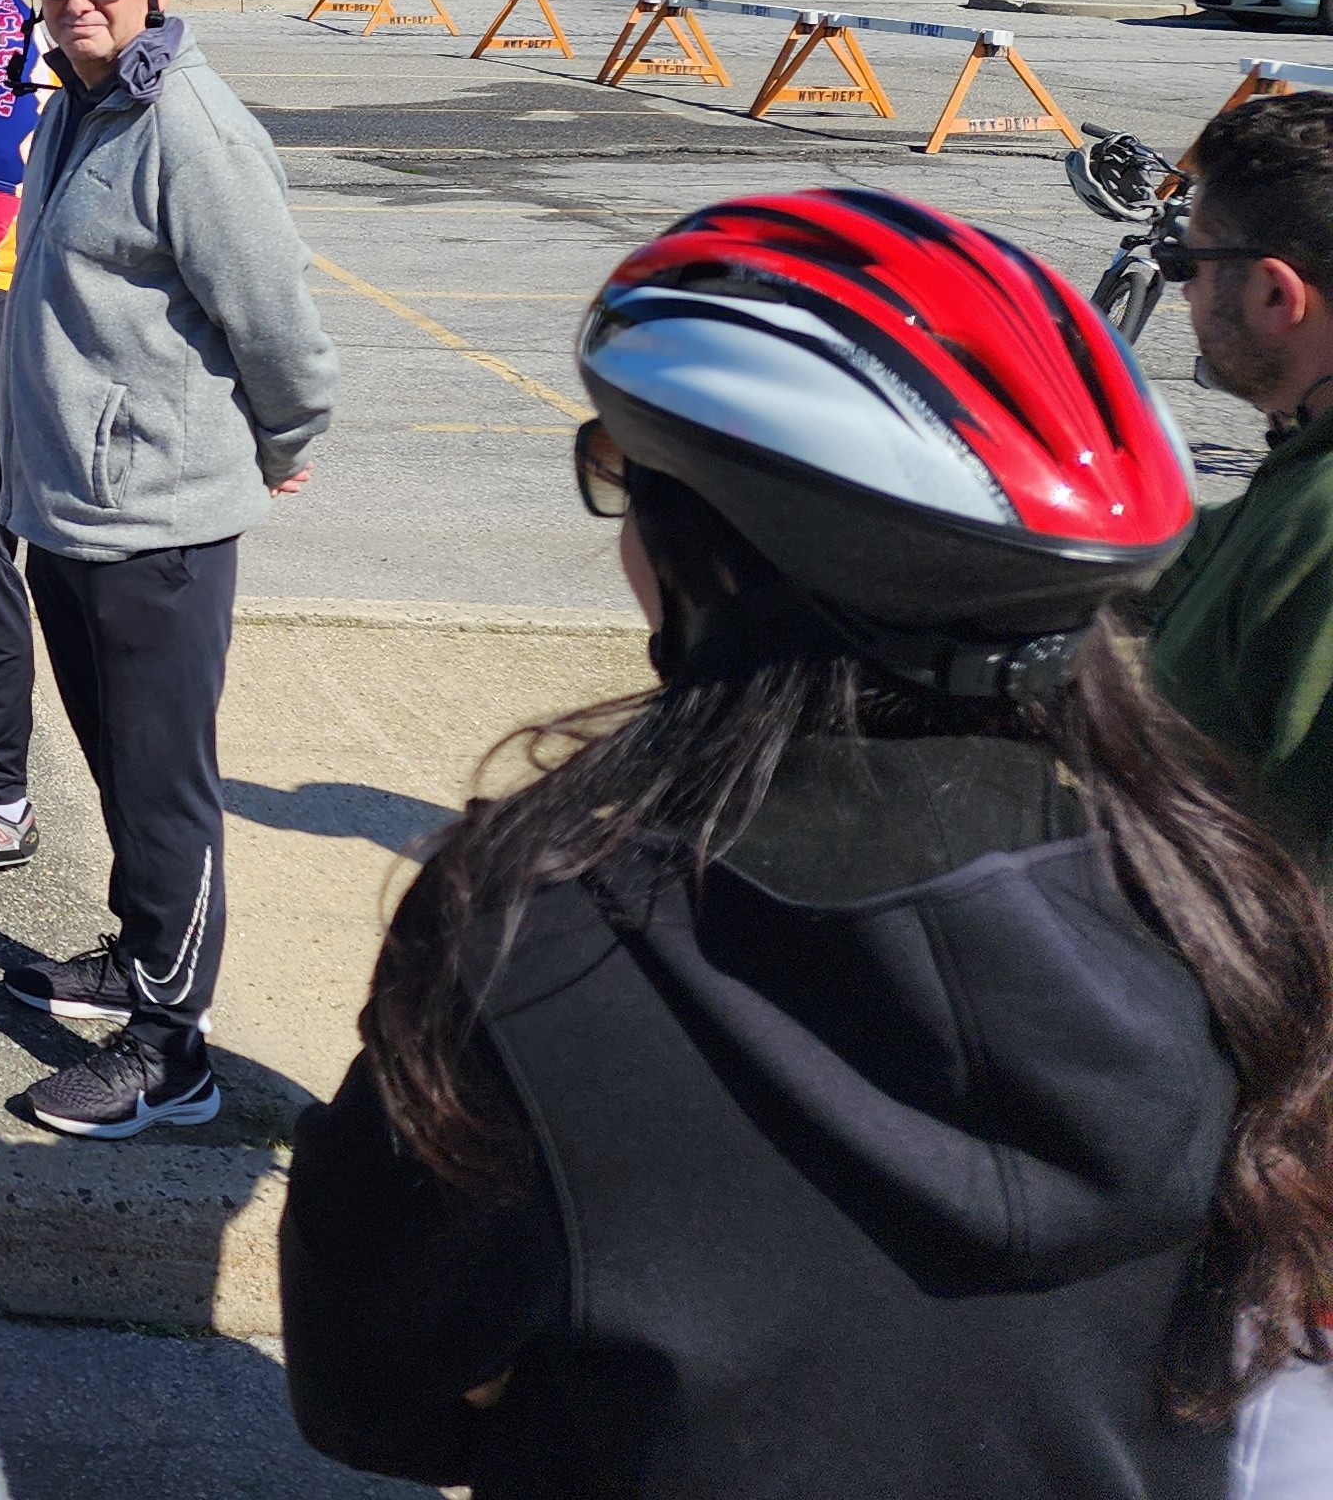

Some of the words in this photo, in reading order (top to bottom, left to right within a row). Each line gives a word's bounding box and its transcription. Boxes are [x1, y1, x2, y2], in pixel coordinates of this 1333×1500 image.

[503, 40, 553, 49] HWY-DEPT
[798, 90, 864, 102] HWY-DEPT
[969, 117, 1039, 132] HWY-DEPT
